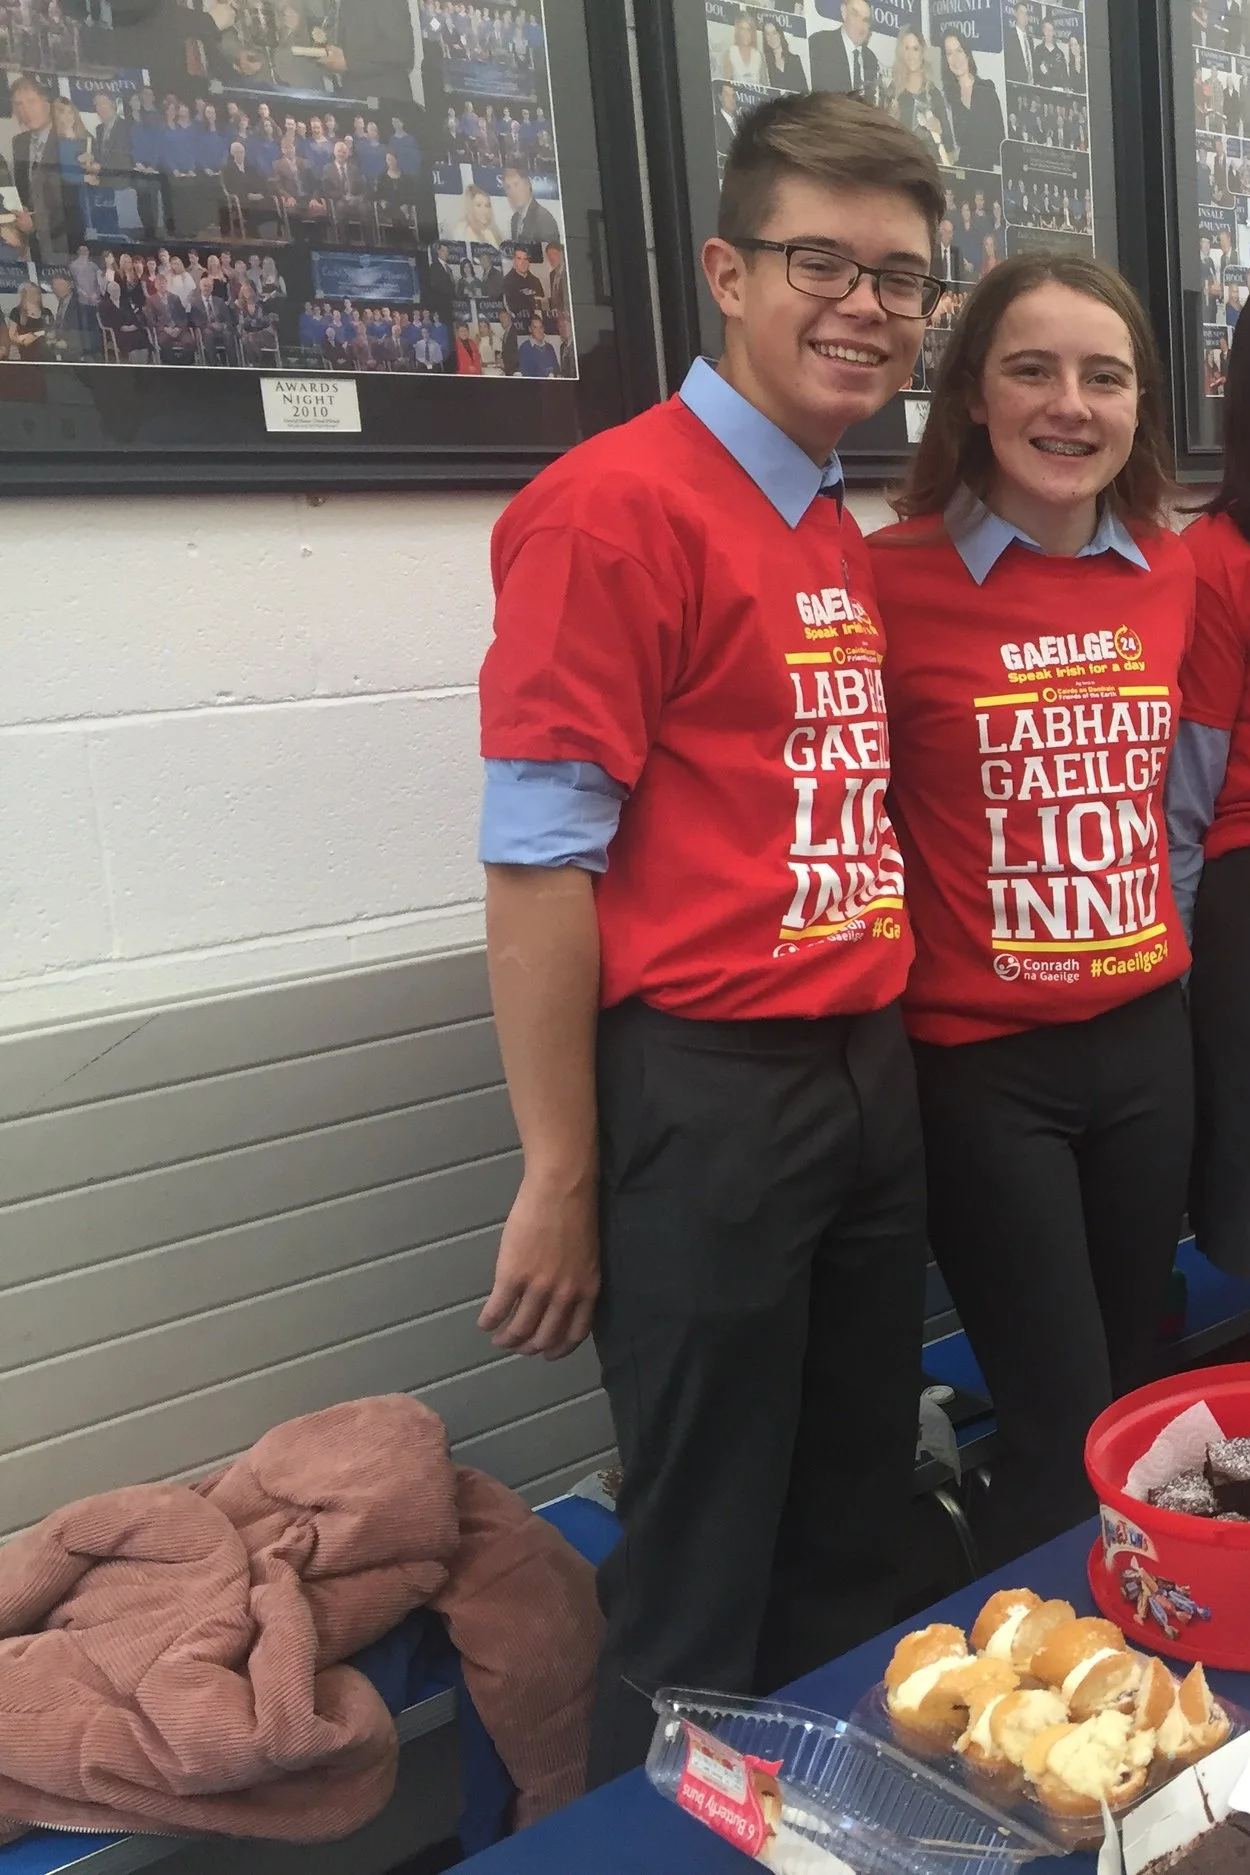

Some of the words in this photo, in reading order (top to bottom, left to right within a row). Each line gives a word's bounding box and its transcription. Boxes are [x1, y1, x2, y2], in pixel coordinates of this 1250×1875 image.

[275, 381, 339, 393] AWARDS
[282, 394, 335, 405] NIGHT
[293, 406, 329, 417] 2010
[1000, 630, 1117, 671] GAEILGE
[1120, 637, 1137, 651] 24
[1008, 669, 1053, 684] Speak
[1056, 665, 1085, 677] Irish
[1088, 662, 1108, 674] for
[1112, 664, 1120, 672] a
[1124, 659, 1146, 671] day
[790, 667, 887, 720] LABHA
[975, 701, 1172, 754] LABHAIR
[980, 746, 1167, 801] GAEILGE
[985, 792, 1159, 874] LIOM
[986, 862, 1160, 940] INNIU
[1023, 958, 1080, 972] Conradh
[1023, 973, 1037, 981] na
[1039, 971, 1080, 985] Gaeilge
[681, 1783, 705, 1810] buns
[704, 1795, 748, 1836] Butterfly
[748, 1824, 756, 1840] 6
